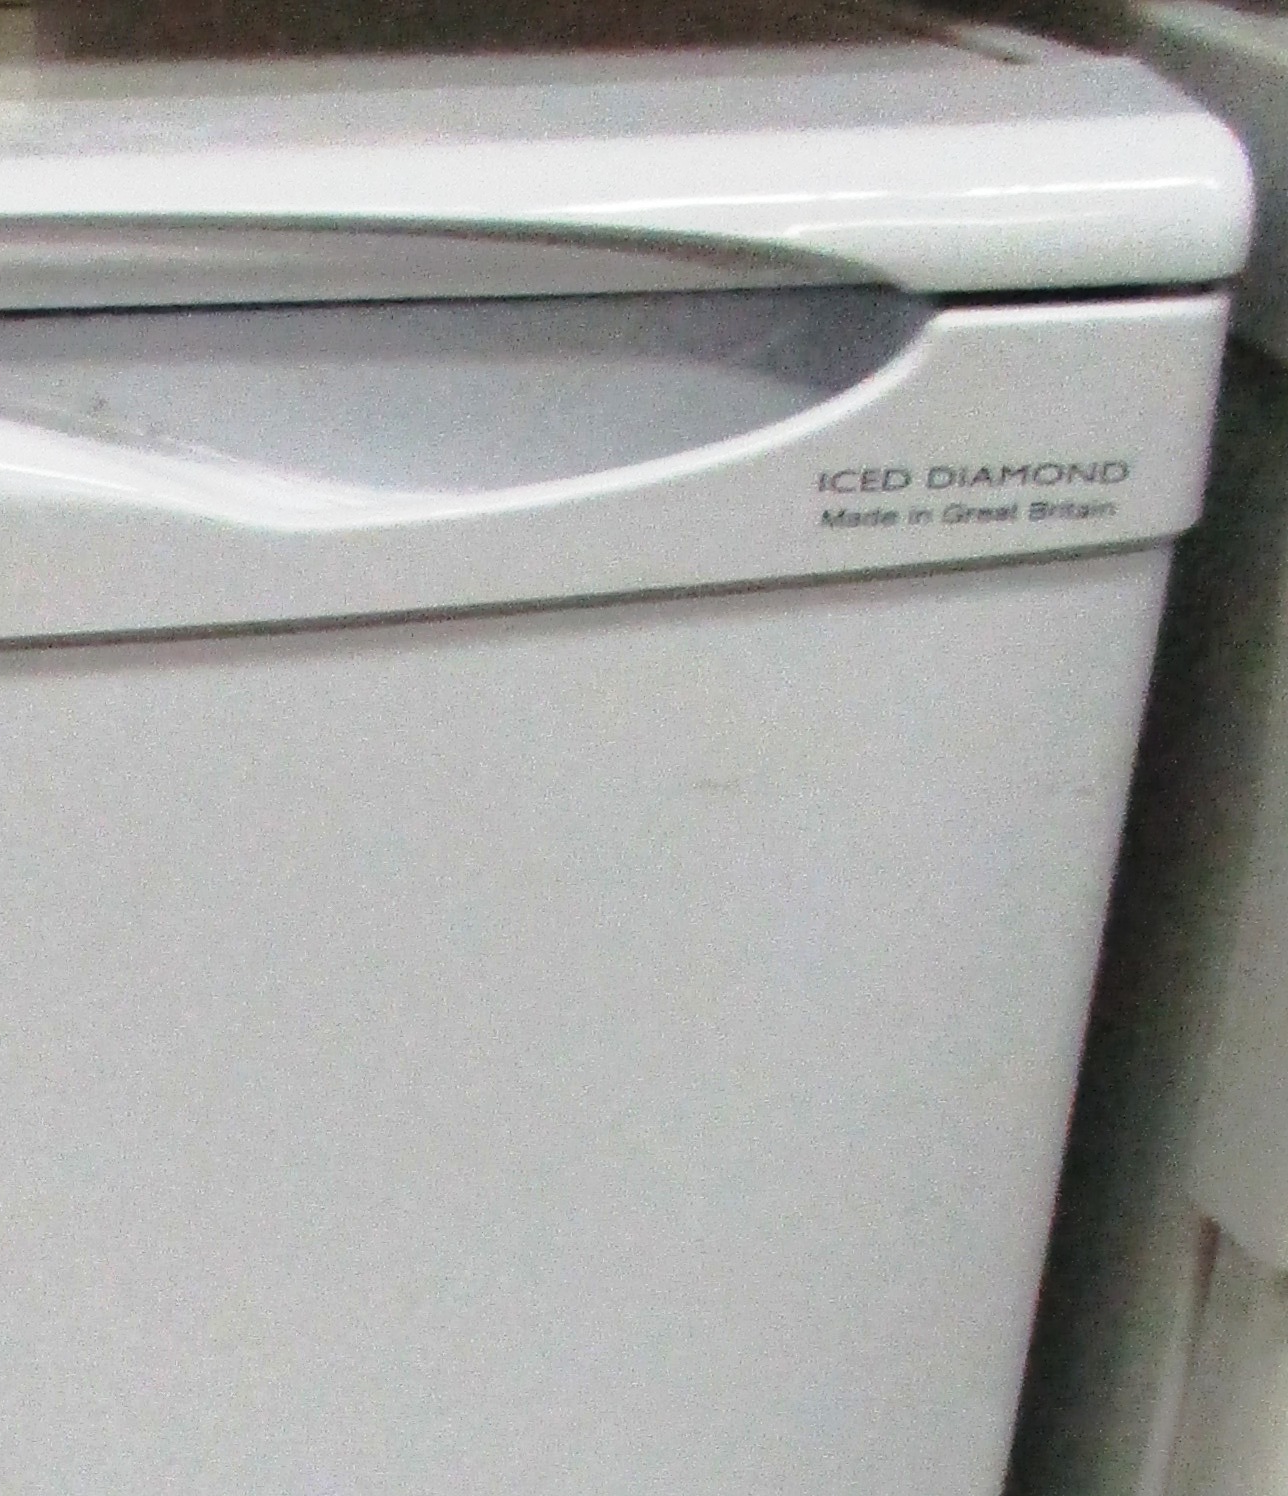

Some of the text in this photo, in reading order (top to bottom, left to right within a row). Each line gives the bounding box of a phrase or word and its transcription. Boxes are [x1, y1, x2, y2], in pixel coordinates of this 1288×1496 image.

[818, 460, 1129, 493] ICED DIAMOND
[820, 500, 1116, 528] Made in Great Britain
